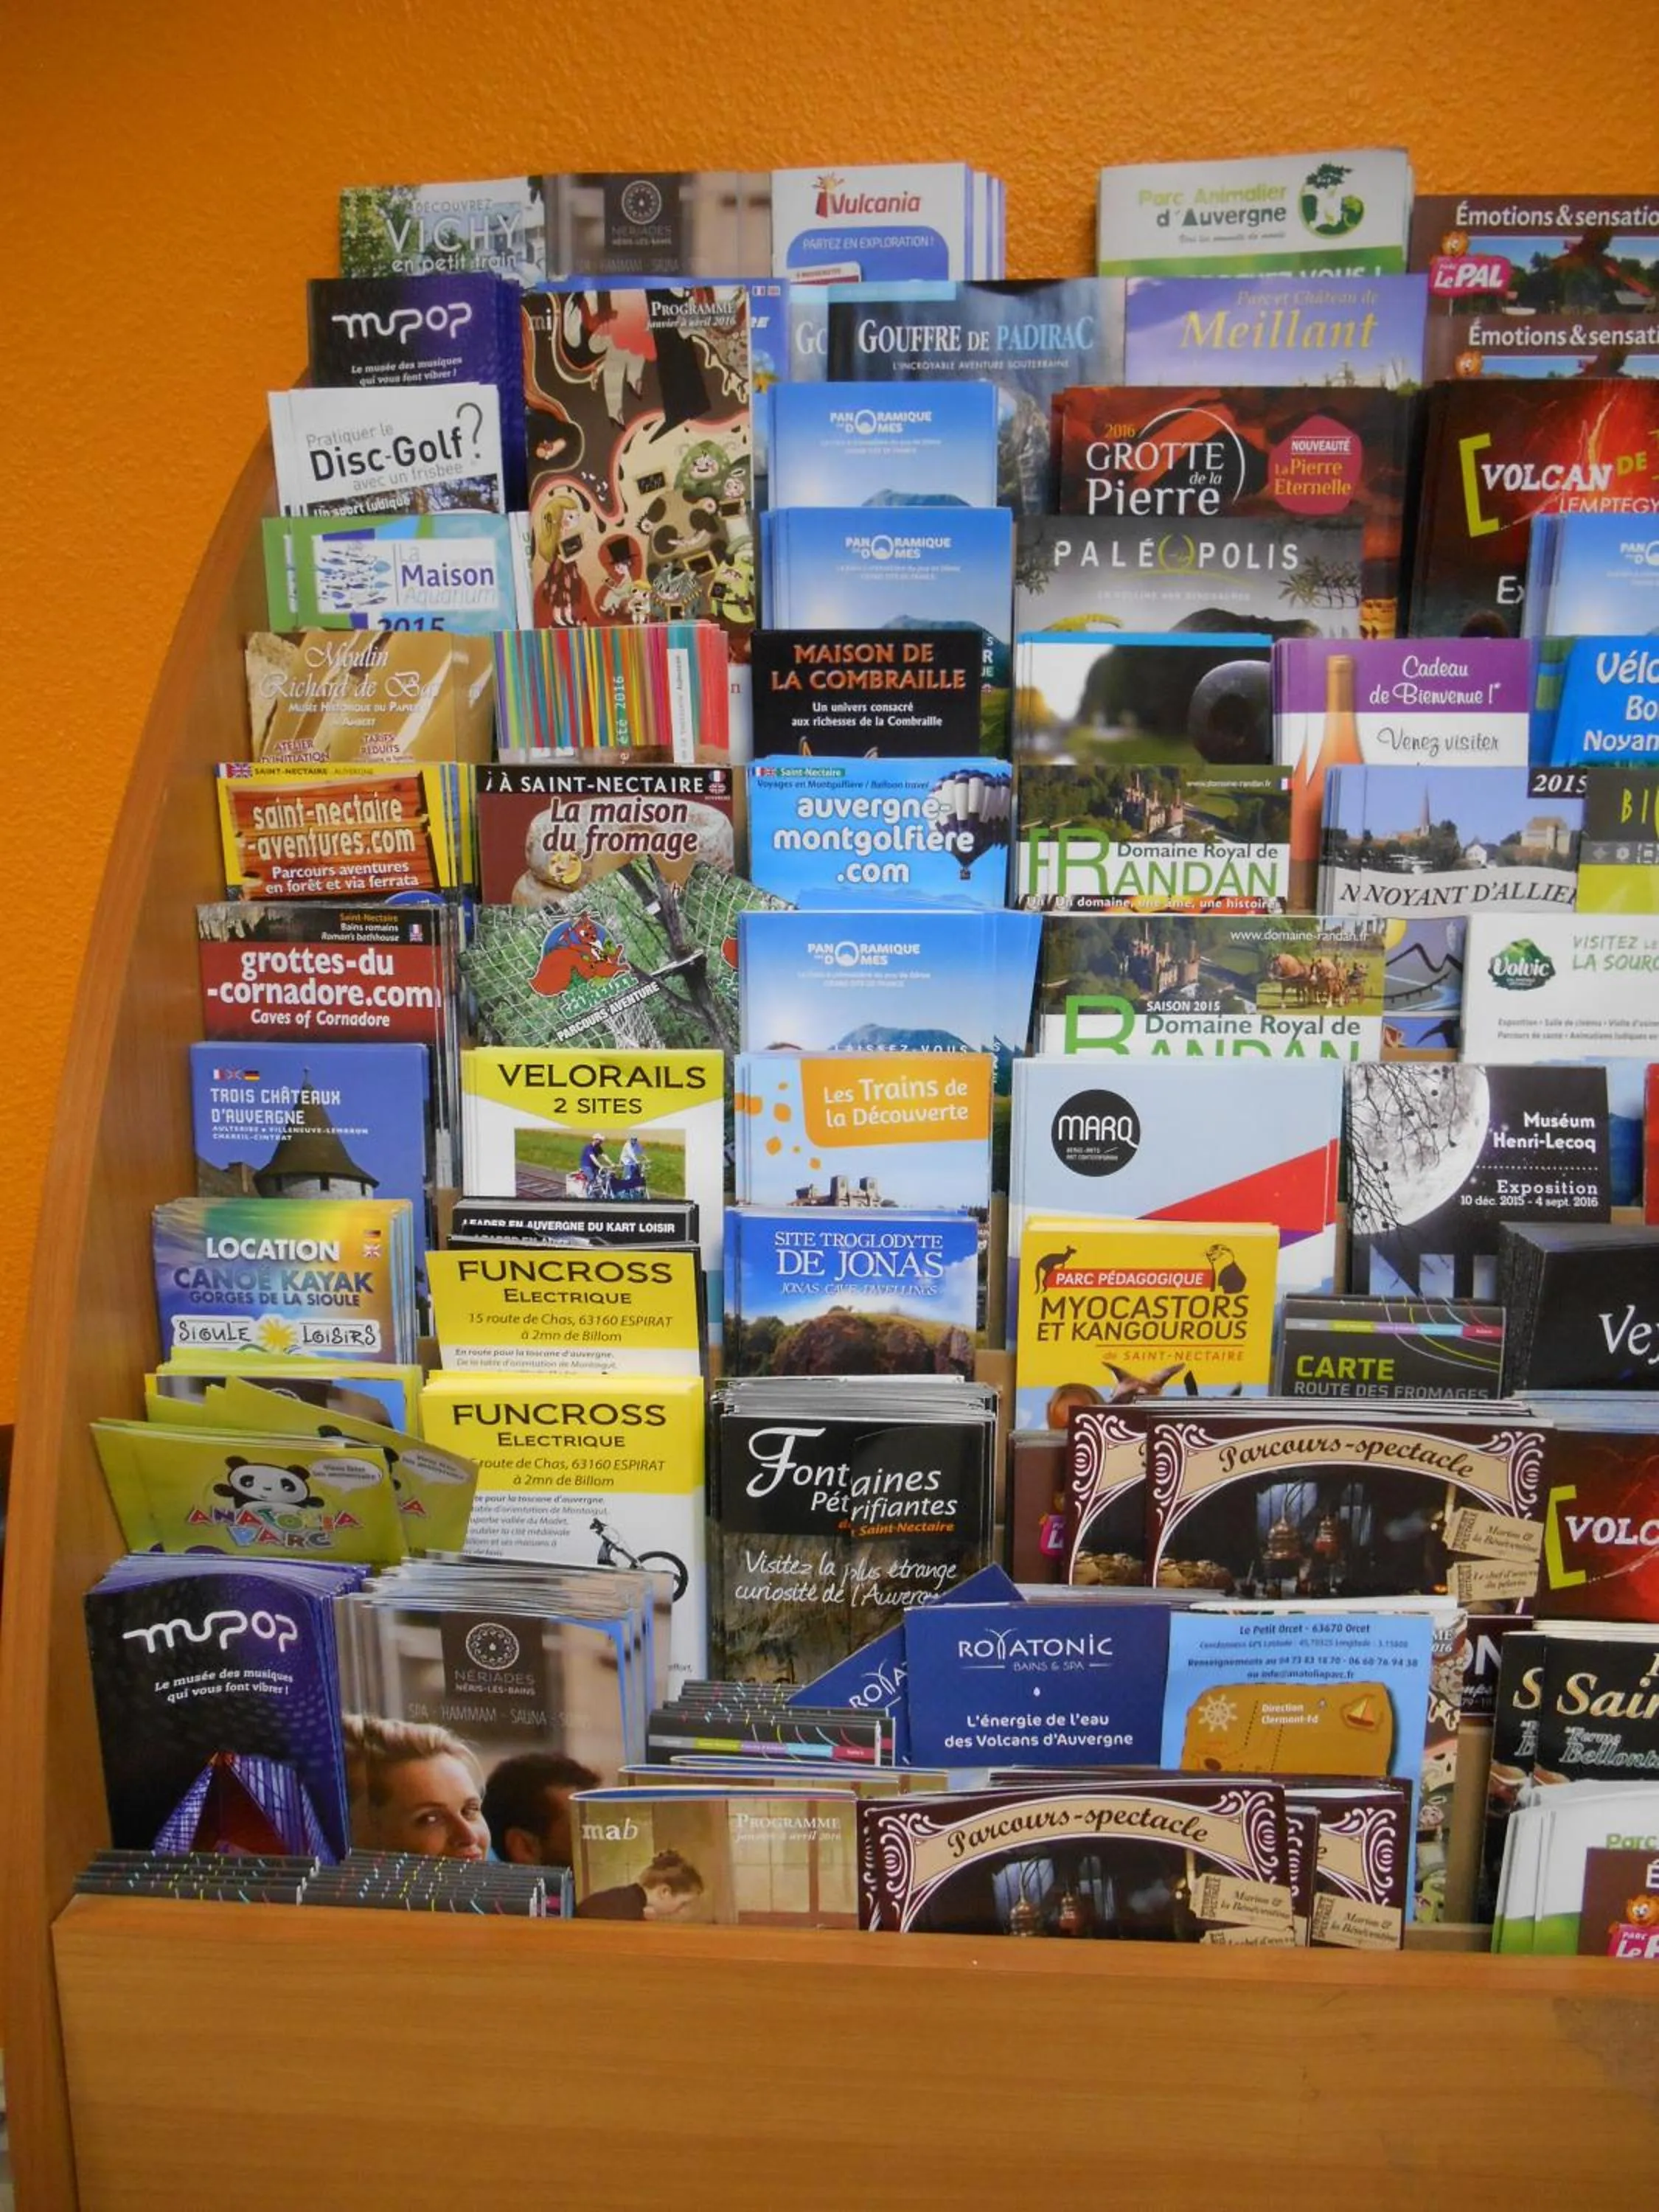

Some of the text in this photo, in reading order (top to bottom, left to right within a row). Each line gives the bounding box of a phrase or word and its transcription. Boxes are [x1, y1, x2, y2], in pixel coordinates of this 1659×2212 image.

[830, 191, 922, 216] Vulcania
[1138, 184, 1287, 206] Parc Animalier
[1456, 201, 1554, 226] Émotions
[1556, 204, 1573, 227] &
[387, 213, 521, 253] VICHY
[803, 235, 929, 250] PARTEZ EN EXPLORATION
[392, 251, 516, 274] en petit train
[651, 300, 736, 317] PROGRAMME
[858, 319, 961, 354] GOUFFRE
[967, 330, 990, 352] DE
[997, 315, 1095, 351] PADIRAC
[1180, 310, 1377, 350] Meillant
[305, 419, 394, 449] Pratiquer le
[1105, 423, 1135, 439] 2016
[1086, 441, 1225, 485] GROTTE de la
[1481, 451, 1647, 491] VOLCAN DE
[1085, 478, 1220, 515] Pierre
[1054, 536, 1298, 571] PALÉOPOLIS
[400, 563, 495, 588] Maison
[406, 588, 495, 607] Aquarium
[305, 641, 389, 669] Moulin
[793, 642, 935, 664] MAISON DE
[1402, 655, 1470, 680] Cadeau
[771, 668, 967, 691] LA COMBRAILLE
[1369, 683, 1484, 706] de Bienvenue
[813, 700, 915, 712] Un univers consacré
[791, 715, 944, 728] aux richesses de la Combraille
[1377, 726, 1499, 757] Venez visiter
[1532, 774, 1588, 794] 2015
[253, 791, 403, 831] saint-nectaire
[551, 796, 689, 824] La maison
[542, 824, 699, 861] du fromage
[1117, 842, 1279, 864] Domaine Royal de
[272, 860, 410, 880] Parcours aventures
[837, 861, 910, 884] .com
[1057, 827, 1278, 897] RANDAN
[265, 873, 420, 895] en forêt et via ferrata
[1230, 929, 1369, 942] www.domaine-randan.fr
[1573, 935, 1638, 950] VISITEZ
[240, 947, 395, 981] grottes-du
[1492, 958, 1550, 977] Volvic
[1147, 1000, 1221, 1013] SAISON 2015
[251, 1009, 391, 1029] Caves of Cornadore
[498, 1063, 706, 1089] VELORAILS
[210, 1085, 341, 1105] TROIS CHÂTEAUX
[823, 1074, 968, 1105] Les Trains de
[554, 1097, 643, 1115] 2 SITES
[826, 1104, 969, 1128] la Découverte
[1523, 1110, 1596, 1129] Muséum
[1057, 1114, 1139, 1150] MARQ
[1493, 1132, 1596, 1154] Henri-Lecoq
[1497, 1179, 1599, 1197] Exposition
[1461, 1194, 1599, 1210] 10 déc. 2015 4 sept. 2016
[528, 1220, 676, 1234] AUVERGNE DU KART LOISIR
[206, 1237, 341, 1262] LOCATION
[774, 1231, 944, 1250] SITE TROGLODYTE
[458, 1259, 674, 1284] FUNCROSS
[776, 1249, 945, 1281] DE JONAS
[174, 1267, 374, 1293] CANOË KAYAK
[1055, 1269, 1204, 1288] PARC PÉDAGOGIQUE
[189, 1290, 361, 1307] GORGES DE LA SIOULE
[1040, 1293, 1250, 1321] MYOCASTORS
[1037, 1320, 1248, 1341] ET KANGOUROUS
[1122, 1349, 1245, 1362] SAINT-NECTAIRE
[1295, 1354, 1395, 1381] CARTE
[452, 1403, 667, 1427] FUNCROSS
[498, 1431, 626, 1449] ELECTRIQUE
[515, 1458, 666, 1472] de Chas, 63160 ESPIRAT
[1219, 1436, 1475, 1479] Parcours-spectacle
[810, 1489, 958, 1525] Pétrifiantes
[226, 1525, 335, 1549] PARC
[735, 1581, 845, 1604] curiosité de
[1239, 1624, 1371, 1635] Le Petit Orcet 63670 Orcet
[454, 1669, 536, 1685] NÉRIADES
[1013, 1661, 1085, 1672] BAINS SPA
[167, 1681, 282, 1703] qui vous font vibrer
[1262, 1703, 1305, 1714] Direction
[967, 1713, 1110, 1730] L'énergie de l'eau
[944, 1732, 1134, 1748] des Volcans d'Auvergne
[581, 1817, 640, 1842] mab
[1605, 1833, 1658, 1850] Parc
